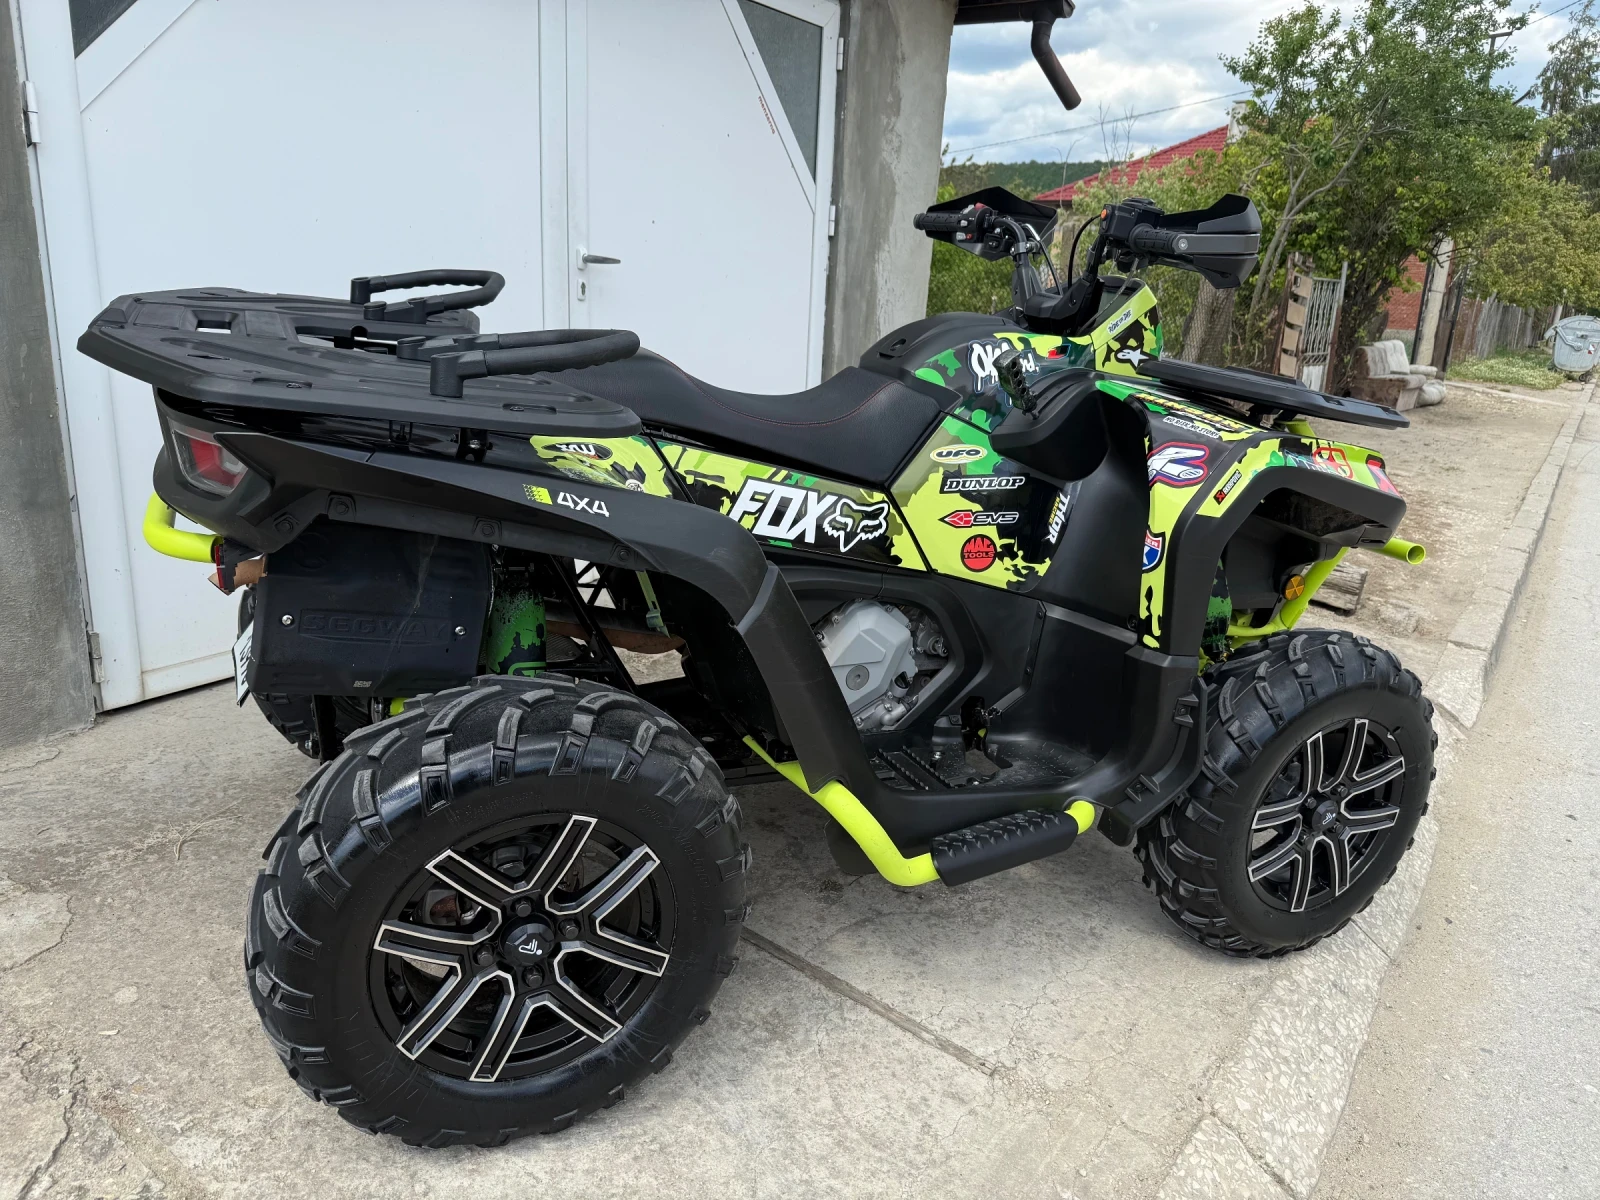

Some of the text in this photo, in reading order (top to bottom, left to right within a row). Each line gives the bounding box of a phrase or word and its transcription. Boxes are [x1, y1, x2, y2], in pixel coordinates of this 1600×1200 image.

[935, 449, 981, 459] UFO
[944, 477, 1025, 491] DUNLOP
[728, 479, 838, 544] FOX
[1045, 492, 1070, 544] THOR
[964, 551, 995, 559] TOOLS
[303, 614, 449, 641] SEGWAY
